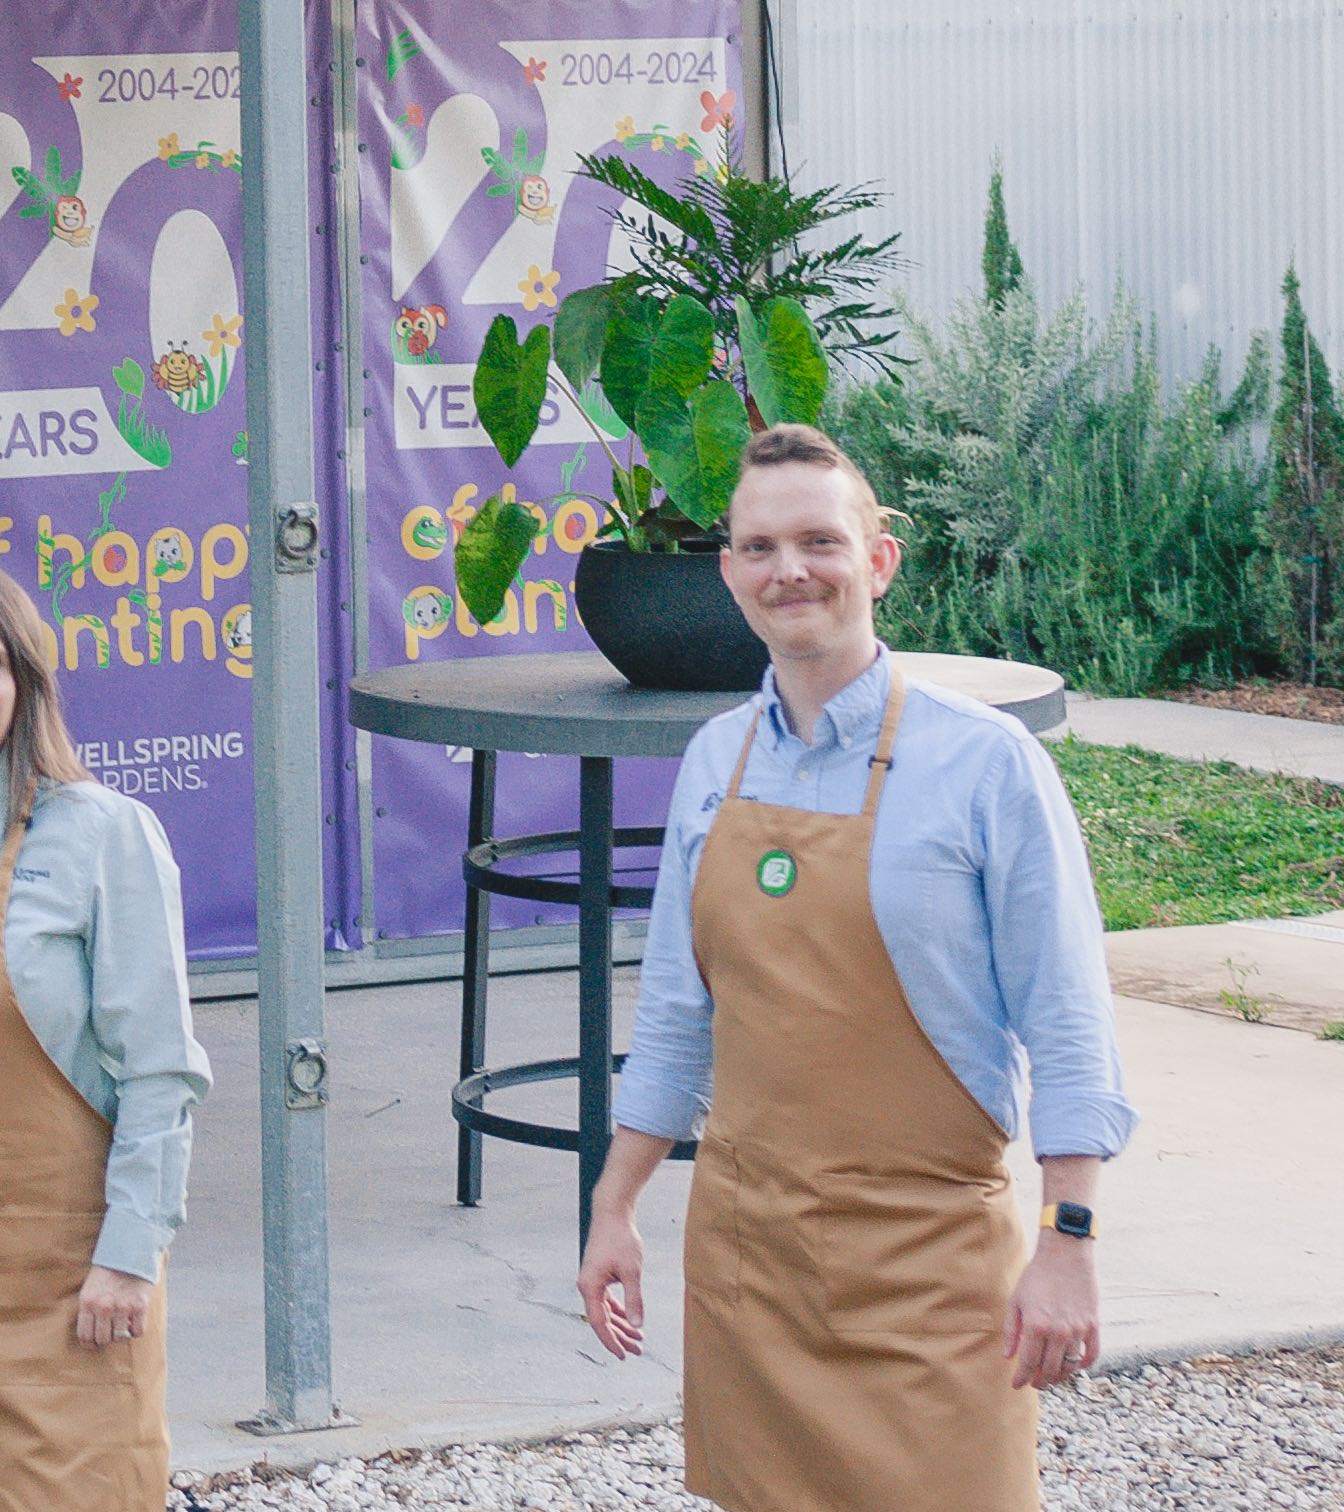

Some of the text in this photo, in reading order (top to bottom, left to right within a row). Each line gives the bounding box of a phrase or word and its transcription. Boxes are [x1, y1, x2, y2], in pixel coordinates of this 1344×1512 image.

[98, 65, 242, 103] 2004-202
[561, 51, 718, 86] 2004-2024
[36, 514, 250, 601] happ
